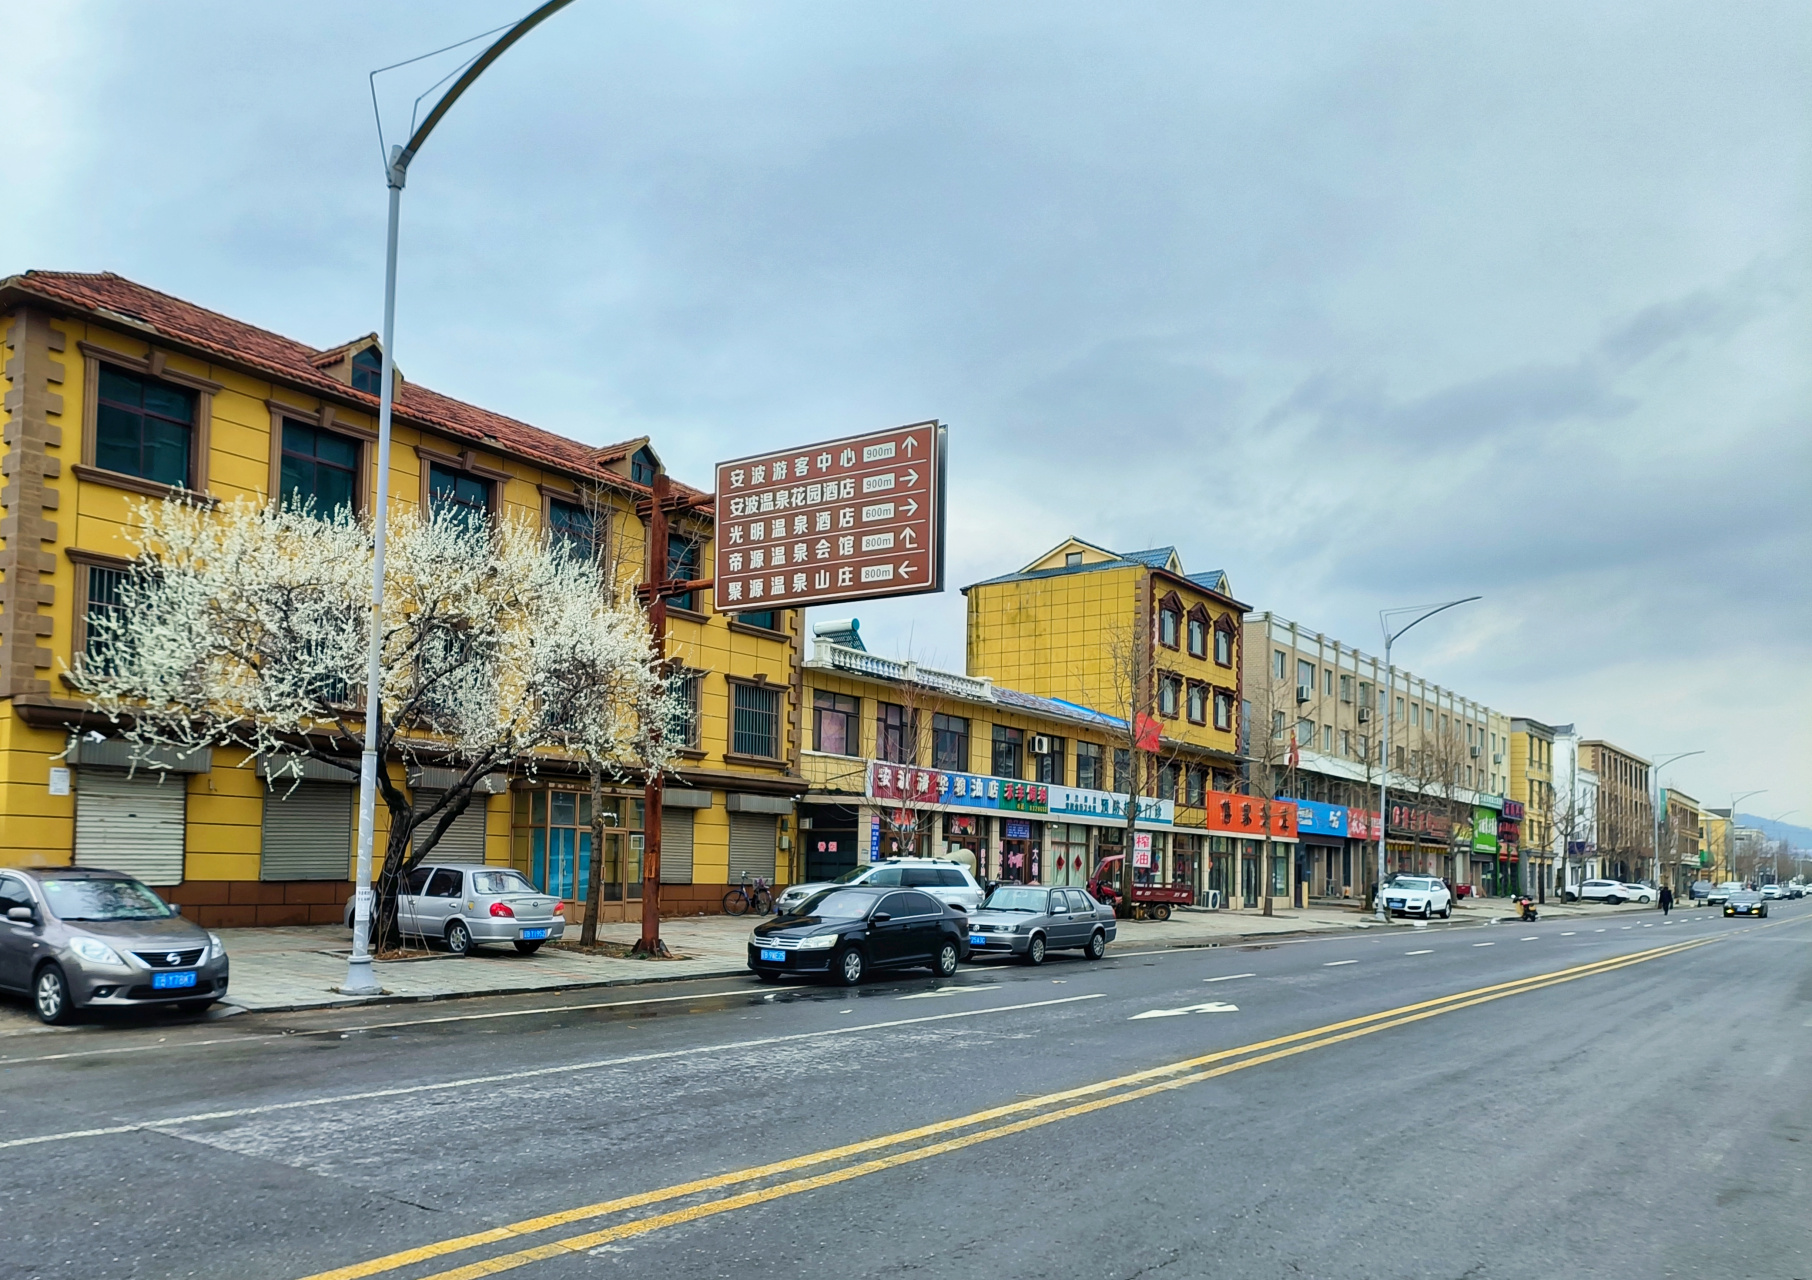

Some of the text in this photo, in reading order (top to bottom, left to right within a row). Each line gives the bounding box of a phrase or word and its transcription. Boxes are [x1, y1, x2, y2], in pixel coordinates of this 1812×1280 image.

[730, 445, 893, 489] 安波游客中心 900m
[729, 477, 892, 518] 安波温泉花园酒店 900m
[728, 507, 892, 545] 光明温泉酒店 600m
[728, 535, 891, 572] 帝源温泉会馆 800m
[728, 566, 891, 601] 聚源温泉山庄 800m
[1135, 834, 1150, 866] 榨油
